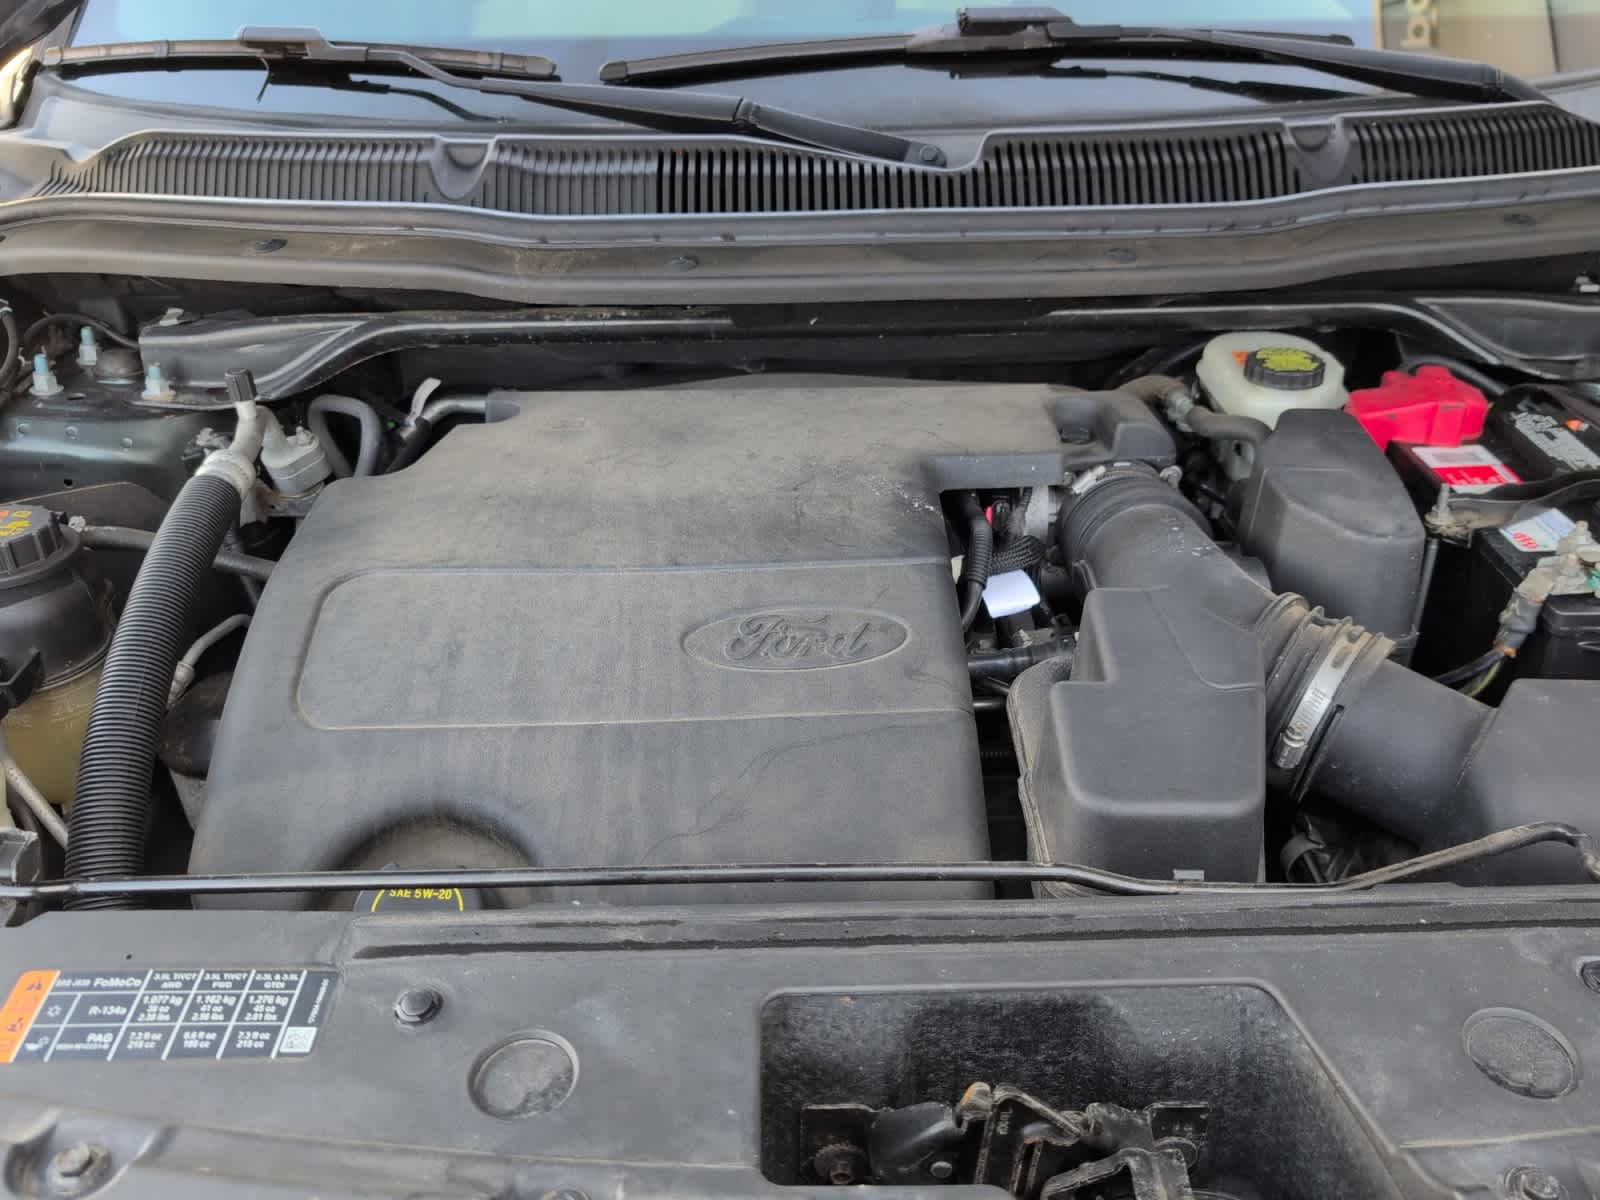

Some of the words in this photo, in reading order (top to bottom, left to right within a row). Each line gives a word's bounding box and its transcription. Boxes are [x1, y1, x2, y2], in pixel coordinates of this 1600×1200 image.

[723, 614, 872, 661] Ford
[414, 888, 452, 900] 5W-20
[93, 977, 143, 988] FoMoCo
[169, 995, 184, 1007] kg
[222, 995, 237, 1007] kg
[275, 995, 289, 1007] kg
[87, 1005, 128, 1016] R-134a
[86, 1032, 114, 1043] PAG
